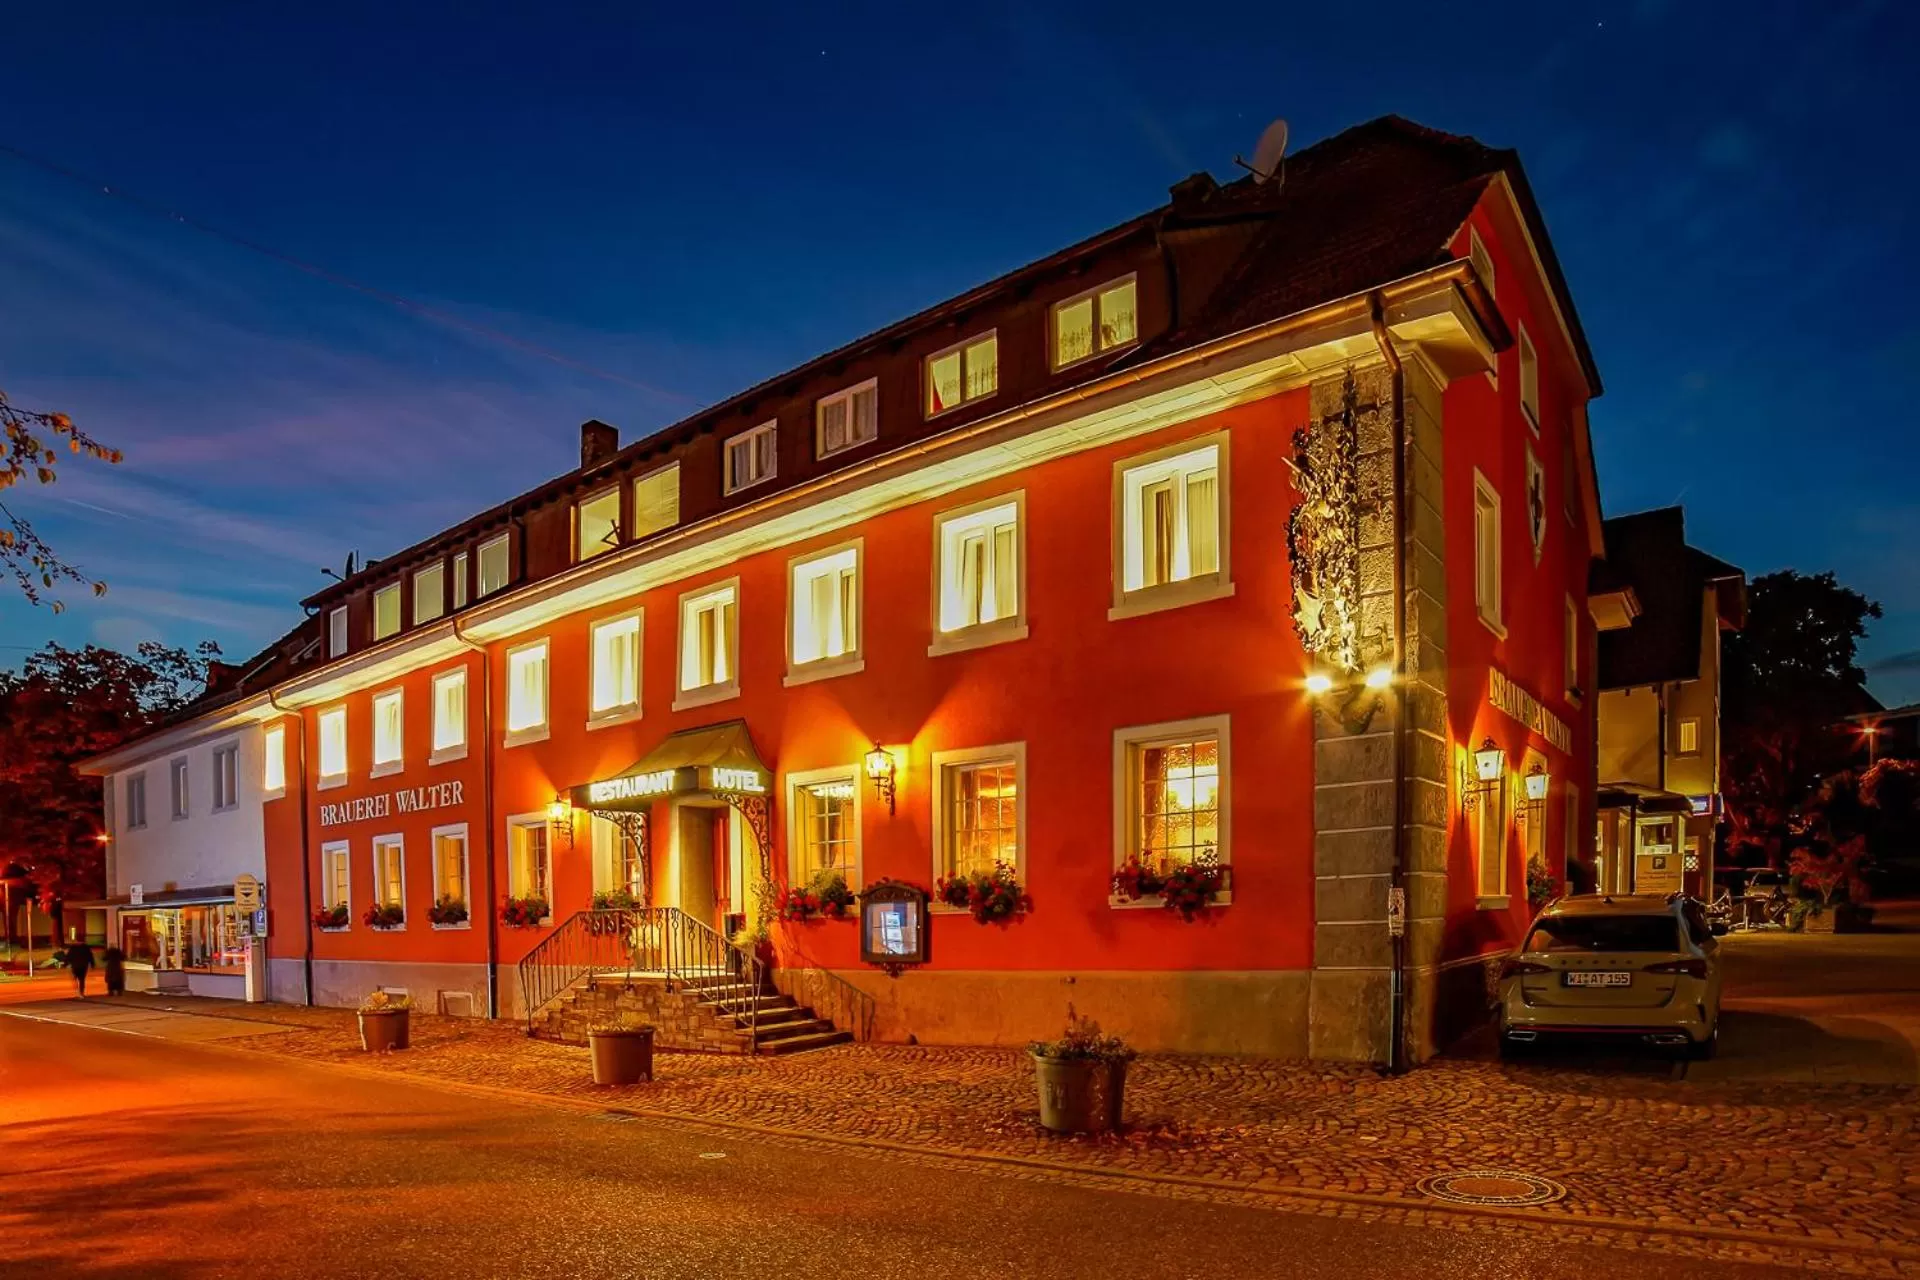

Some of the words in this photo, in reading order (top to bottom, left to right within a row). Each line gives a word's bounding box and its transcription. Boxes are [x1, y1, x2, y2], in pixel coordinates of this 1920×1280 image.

[590, 769, 676, 803] RESTAURANT
[713, 768, 765, 792] HOTEL
[320, 793, 390, 826] BRAUEREI
[396, 780, 464, 813] WALTER
